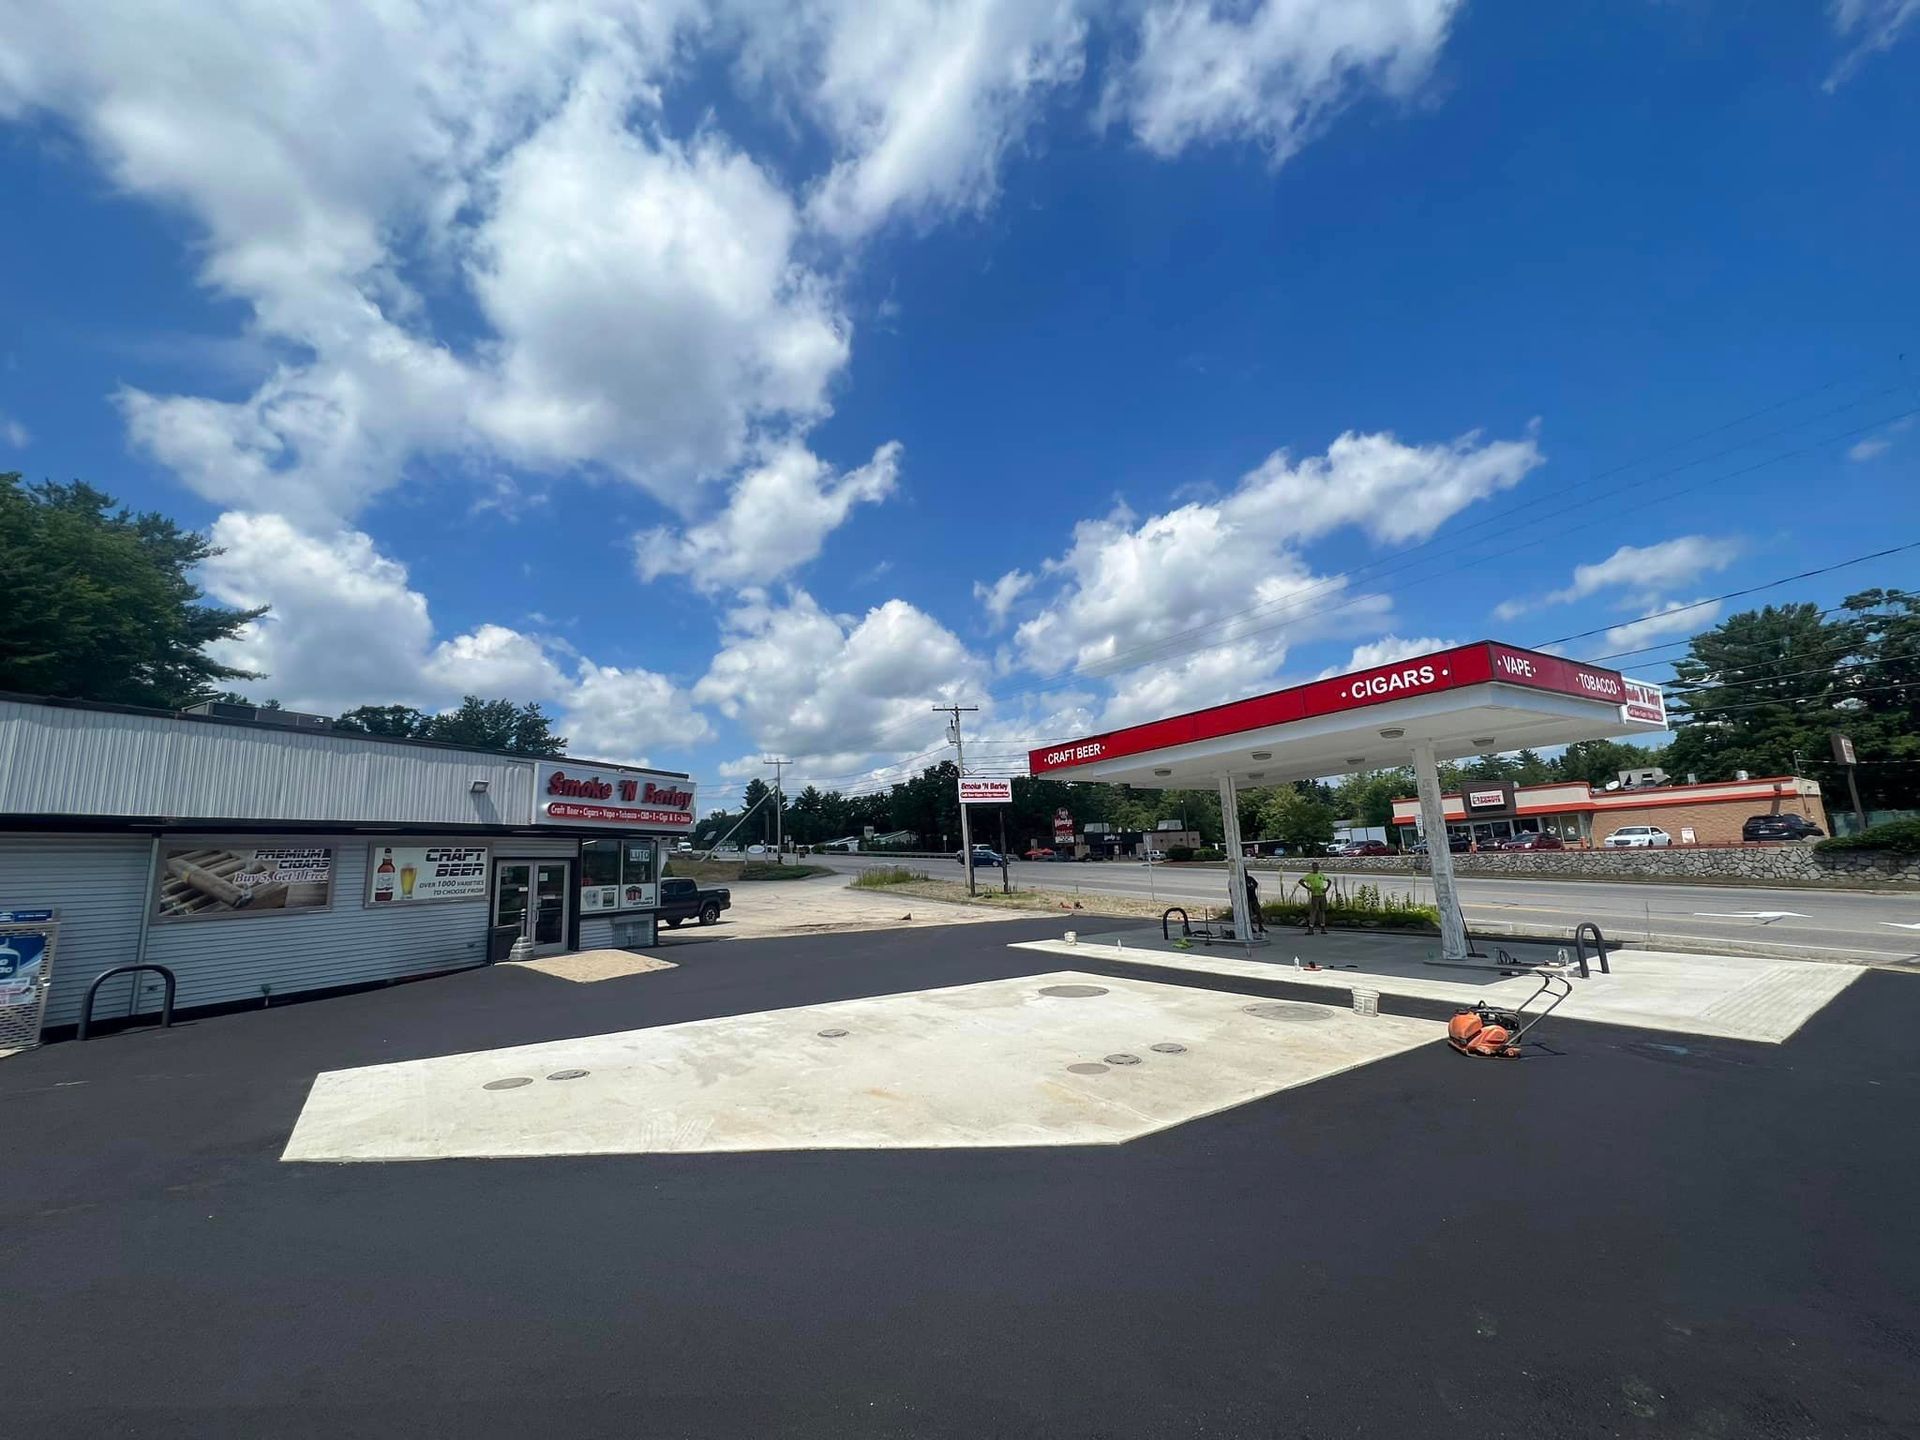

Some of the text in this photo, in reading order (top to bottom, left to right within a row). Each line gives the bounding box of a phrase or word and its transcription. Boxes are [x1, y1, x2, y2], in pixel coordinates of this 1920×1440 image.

[1502, 655, 1532, 677] VAPE
[1351, 666, 1435, 698] CIGARS
[1578, 673, 1618, 695] TOBACCO
[1047, 743, 1101, 764] CRAFT BEER
[547, 771, 613, 799] Smoke
[641, 783, 693, 810] Barley
[990, 782, 1008, 790] Barley
[551, 804, 565, 814] Craft
[567, 806, 579, 814] Beer
[584, 808, 598, 818] Cigars
[254, 849, 322, 859] PREMIUM
[425, 848, 486, 862] CRAFT
[278, 860, 330, 869] CIGARS
[435, 863, 484, 877] BEER
[234, 871, 257, 885] Buy
[272, 871, 291, 881] Get
